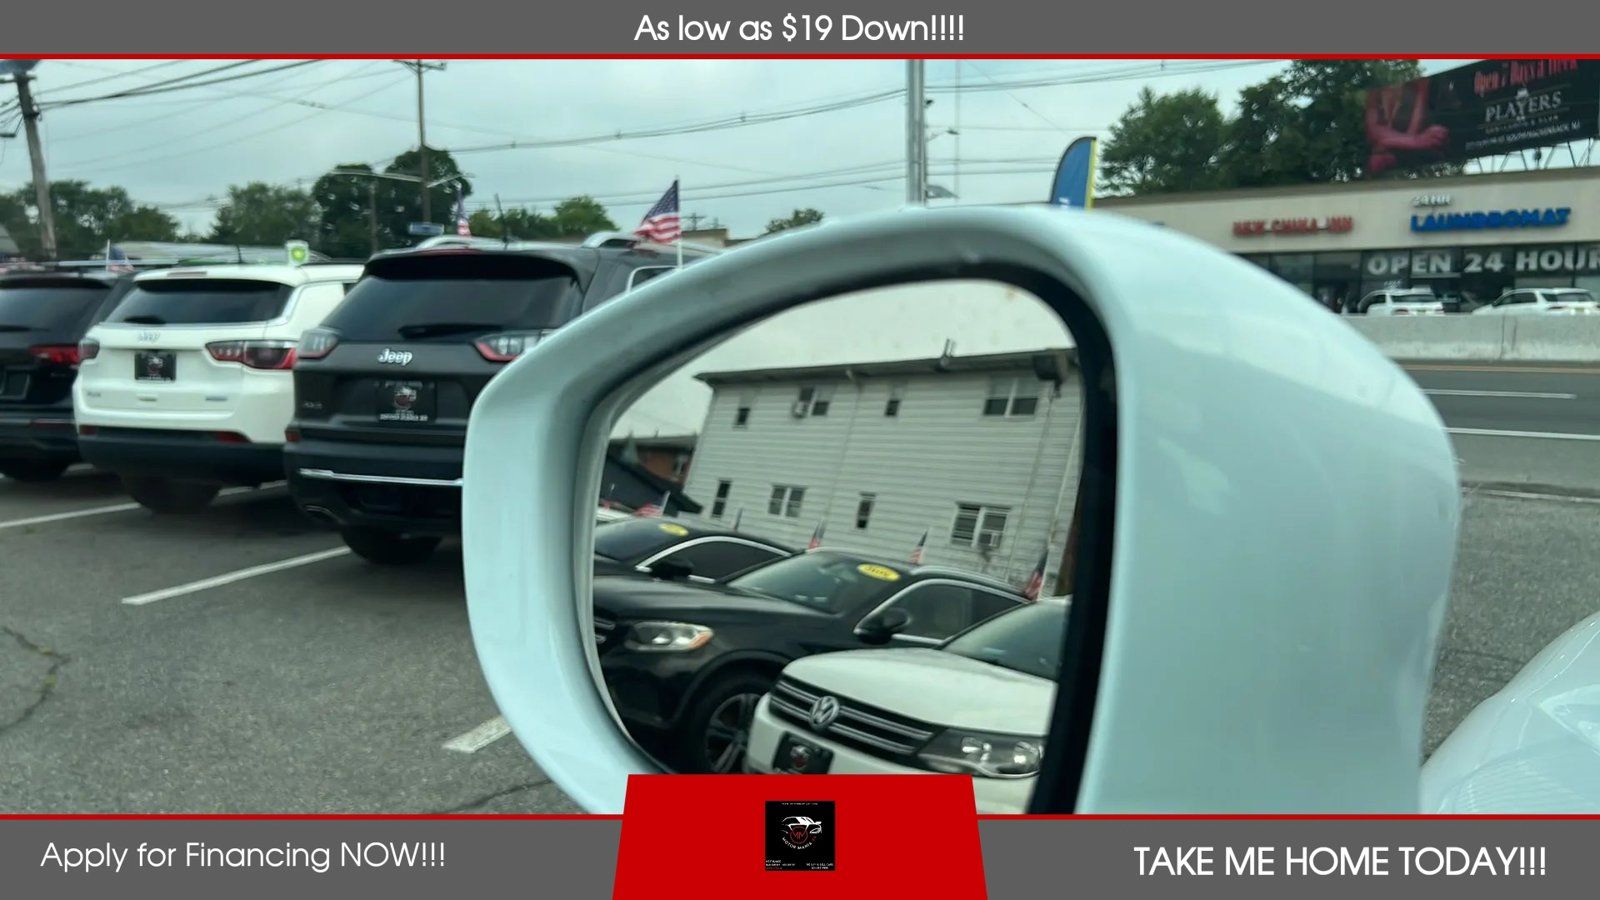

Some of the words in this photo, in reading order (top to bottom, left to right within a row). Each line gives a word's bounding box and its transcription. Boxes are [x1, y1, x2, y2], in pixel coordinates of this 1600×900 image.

[1485, 91, 1562, 122] PLAYERS
[1232, 220, 1265, 236] NEW
[1271, 217, 1318, 235] CHINA
[1326, 215, 1354, 233] INN
[1410, 206, 1571, 234] LAUNDROMAT
[1367, 252, 1450, 275] OPEN
[1464, 251, 1505, 273] 24
[1515, 249, 1600, 272] HOUR
[377, 348, 413, 366] Jeep
